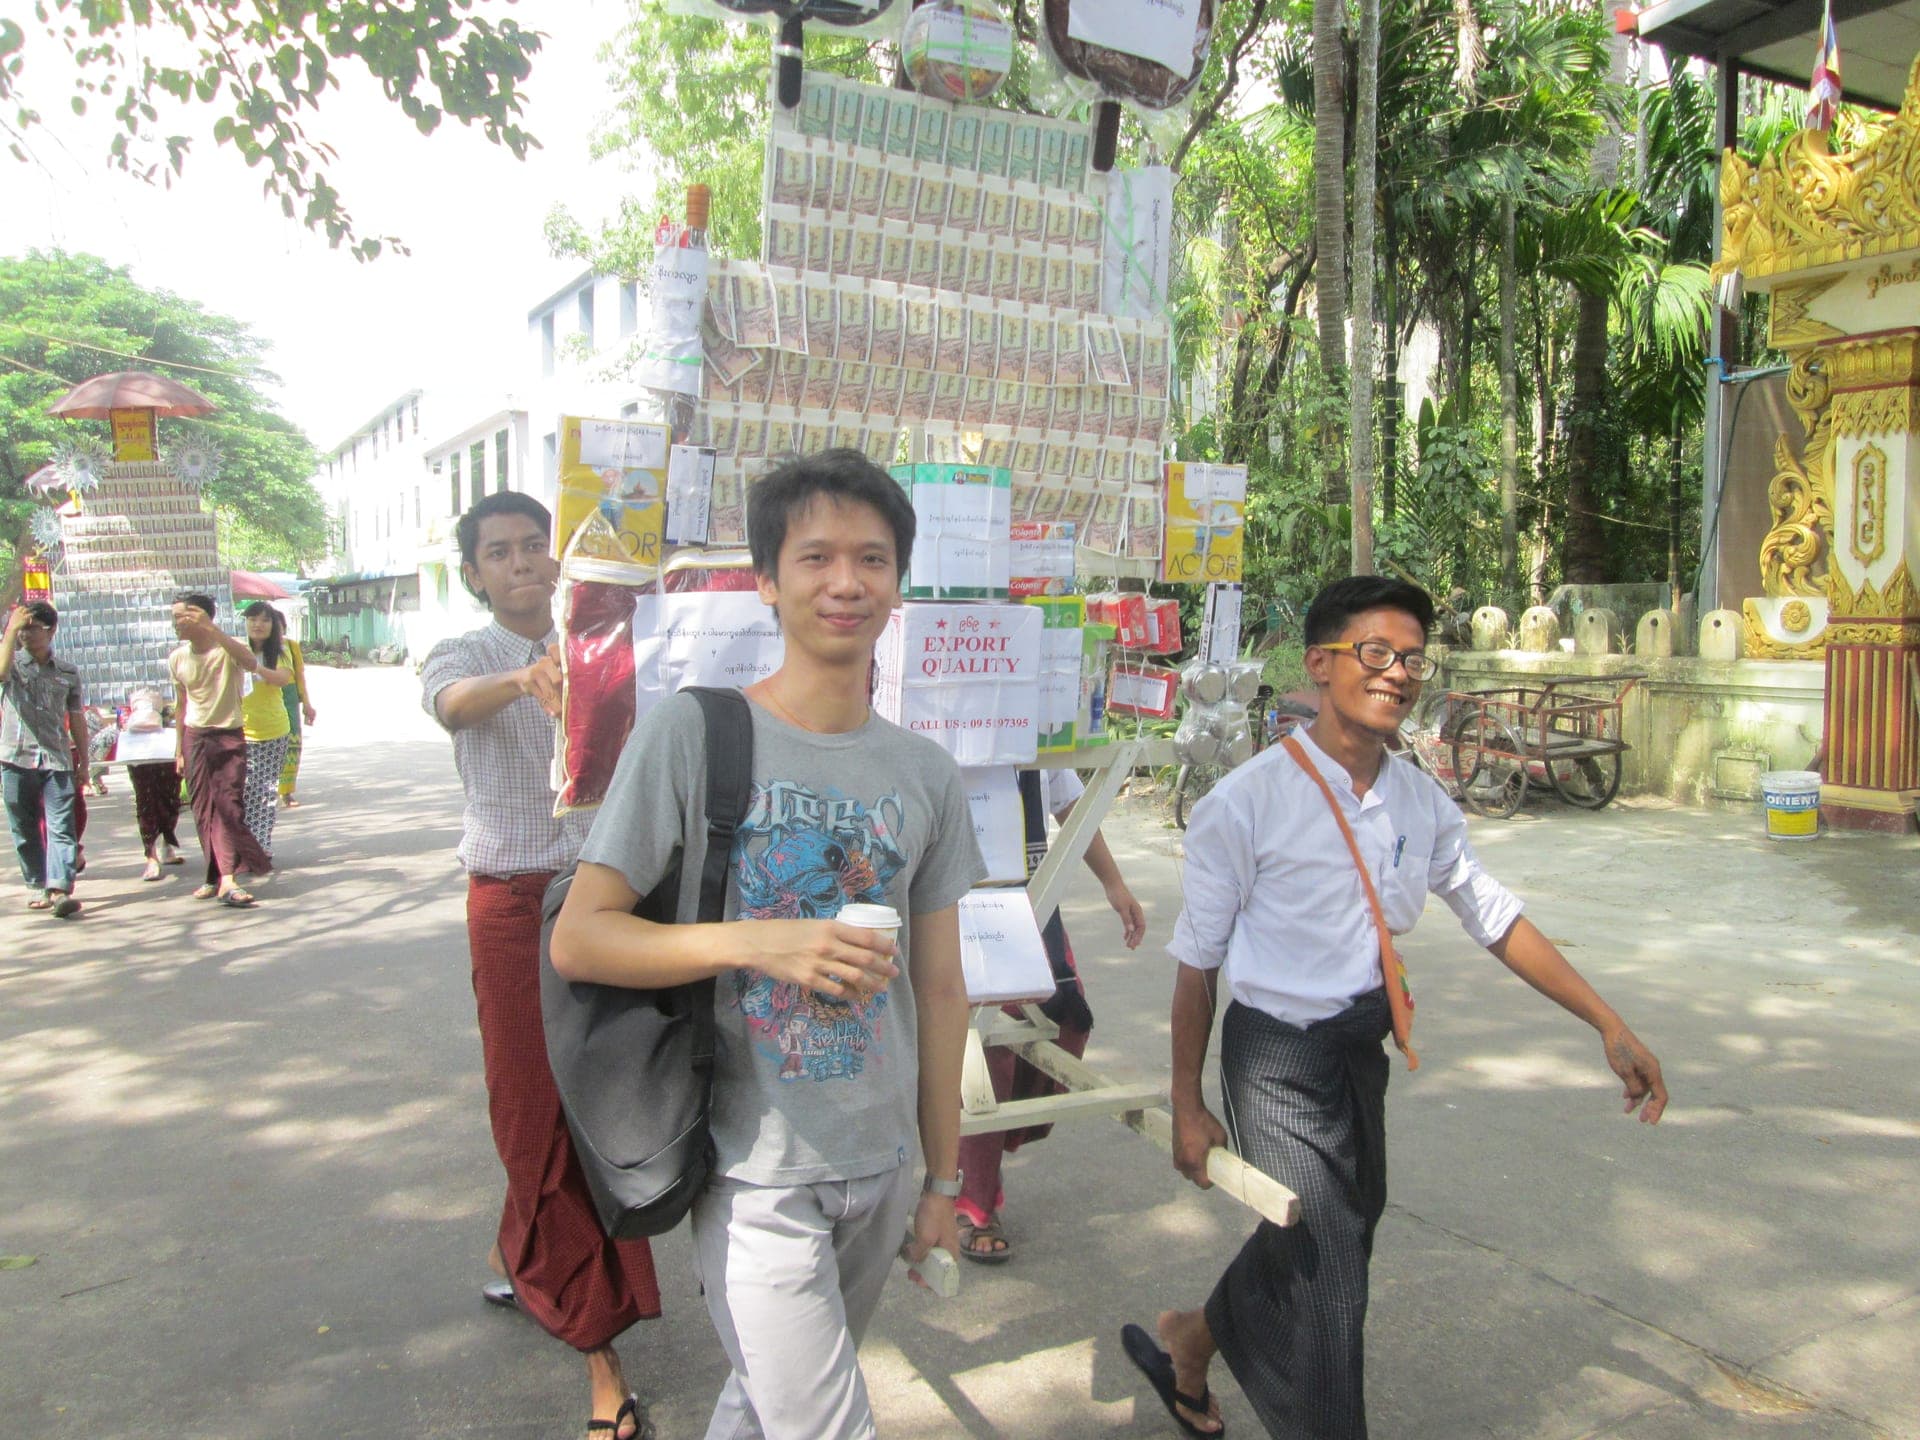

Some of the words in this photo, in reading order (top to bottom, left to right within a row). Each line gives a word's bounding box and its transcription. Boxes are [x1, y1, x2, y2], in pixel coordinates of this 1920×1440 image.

[923, 636, 1011, 653] EXPORT
[922, 657, 1021, 677] QUALITY
[910, 719, 941, 731] CALL
[944, 718, 960, 730] US
[970, 718, 983, 729] 09
[1766, 795, 1817, 806] ORIENT
